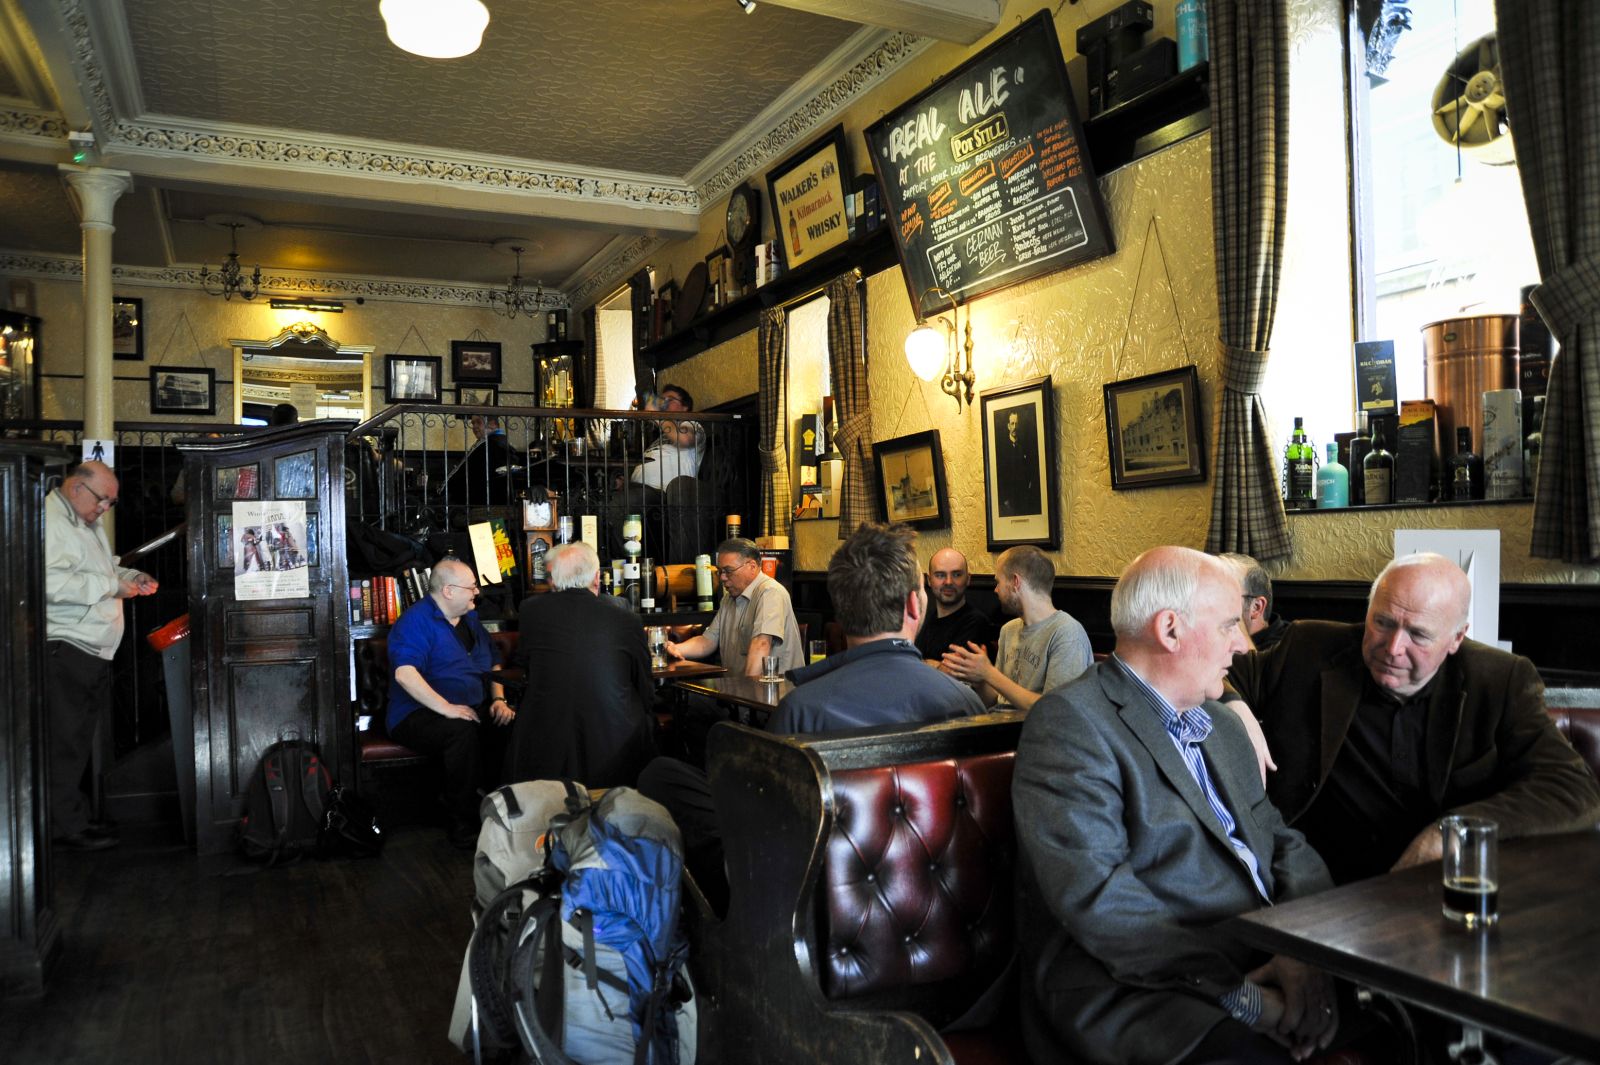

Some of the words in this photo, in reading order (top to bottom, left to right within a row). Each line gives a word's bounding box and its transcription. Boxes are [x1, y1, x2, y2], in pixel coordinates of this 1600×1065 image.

[889, 107, 946, 163] REAL
[958, 66, 1010, 124] ALE
[899, 165, 909, 187] AT
[914, 151, 937, 177] THE
[1001, 143, 1030, 172] HOUSTON
[779, 171, 819, 207] WALKER'S
[902, 179, 928, 200] SUPPORT
[930, 170, 949, 186] YOUR
[951, 161, 971, 176] LOCAL
[807, 211, 841, 240] WHISKY
[966, 220, 1003, 258] GERMAN
[944, 243, 954, 257] NOT
[979, 241, 1005, 267] BEER
